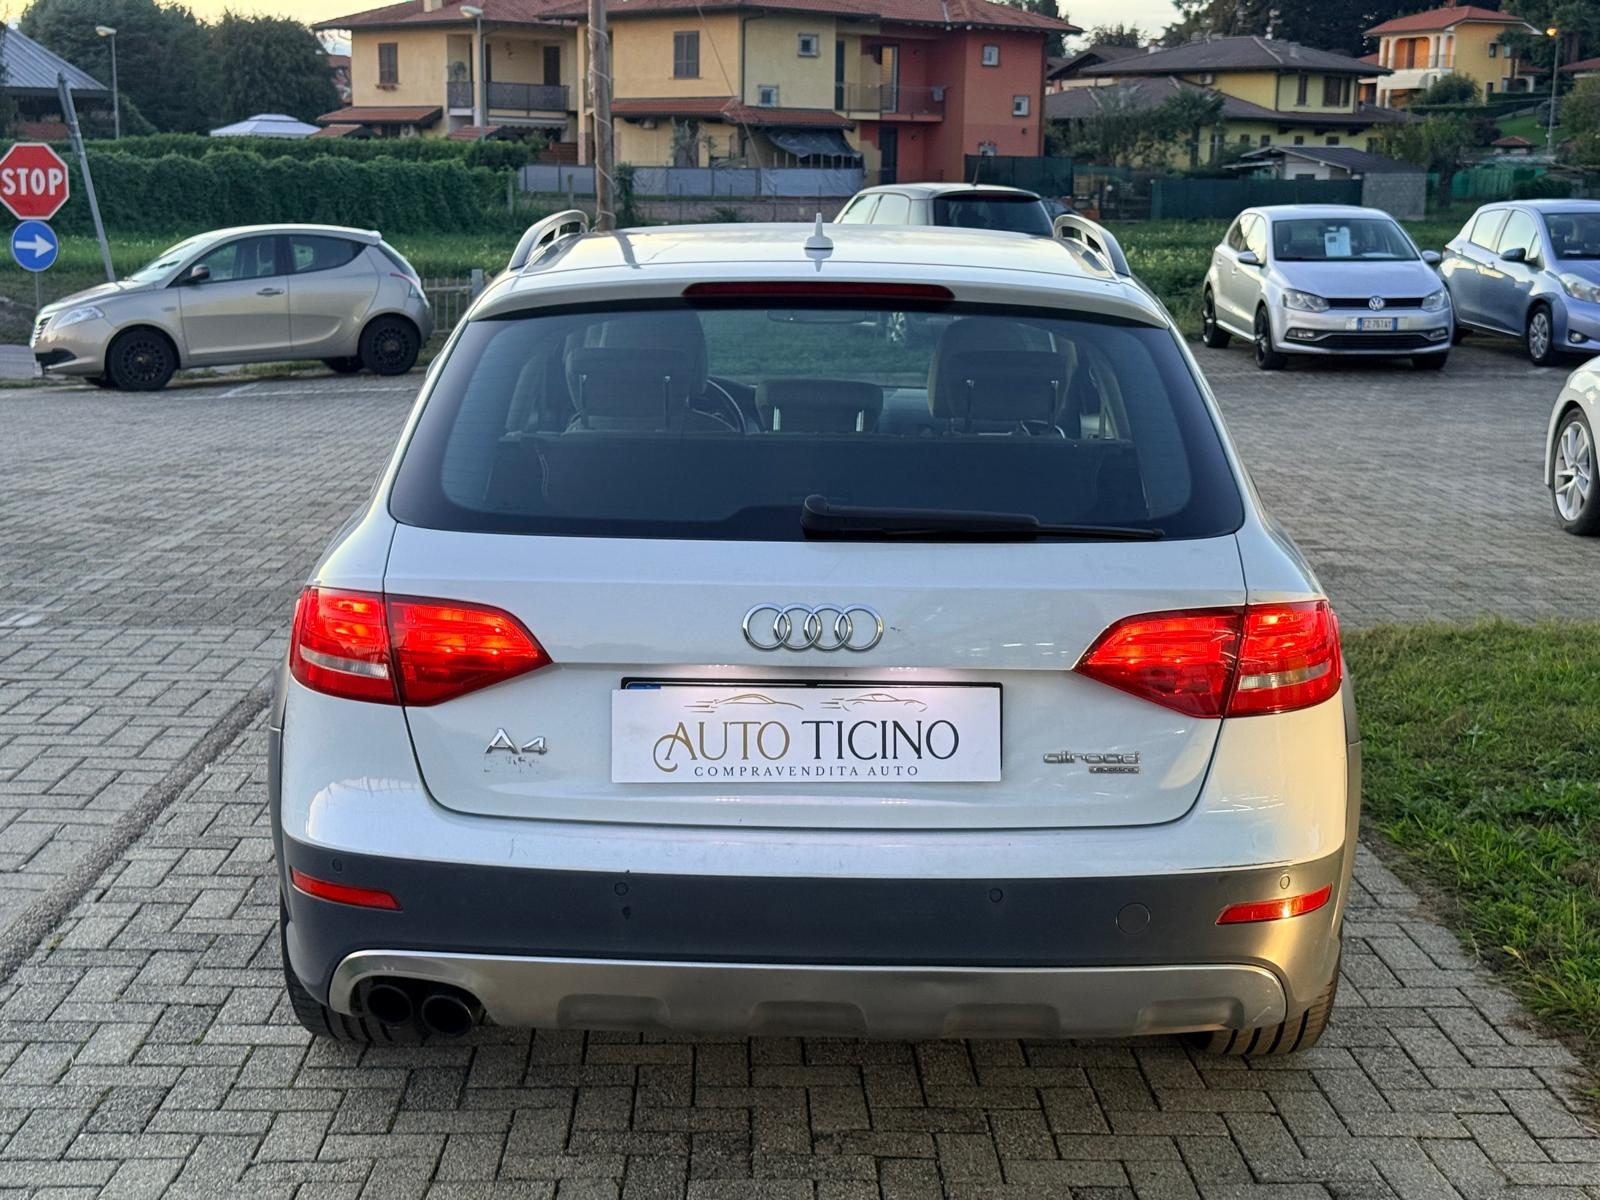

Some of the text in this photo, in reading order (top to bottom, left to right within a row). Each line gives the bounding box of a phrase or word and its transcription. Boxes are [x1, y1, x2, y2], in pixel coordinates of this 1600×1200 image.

[1, 167, 64, 196] STOP
[485, 727, 547, 755] A4
[653, 719, 960, 773] AUTO TICINO
[694, 765, 919, 777] COMPRAVENDITA AUTO
[1043, 751, 1140, 764] allroad
